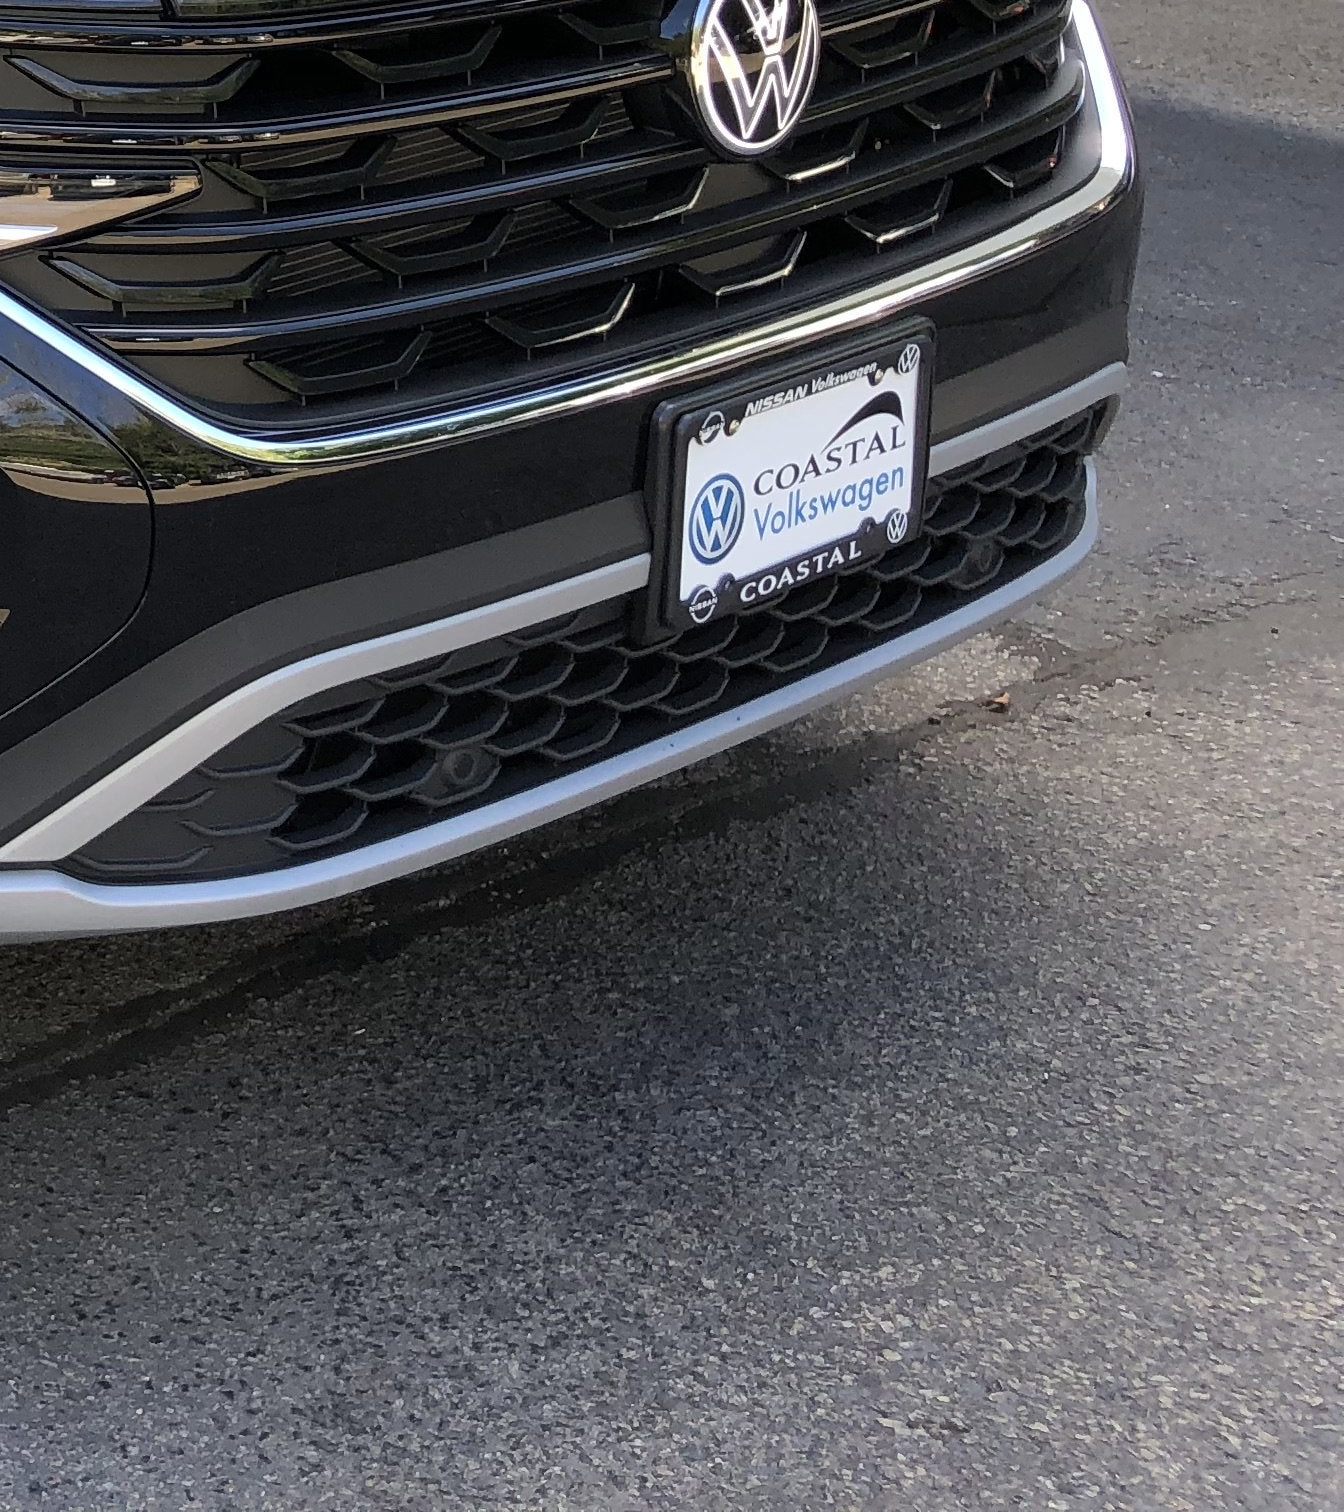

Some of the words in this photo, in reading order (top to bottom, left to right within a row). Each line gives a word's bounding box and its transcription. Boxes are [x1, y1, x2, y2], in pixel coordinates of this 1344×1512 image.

[745, 383, 808, 417] NISSAN
[812, 361, 878, 394] Volkswagen
[753, 425, 906, 496] COASTAL
[754, 466, 904, 540] Volkswagen
[740, 541, 862, 602] COASTAL
